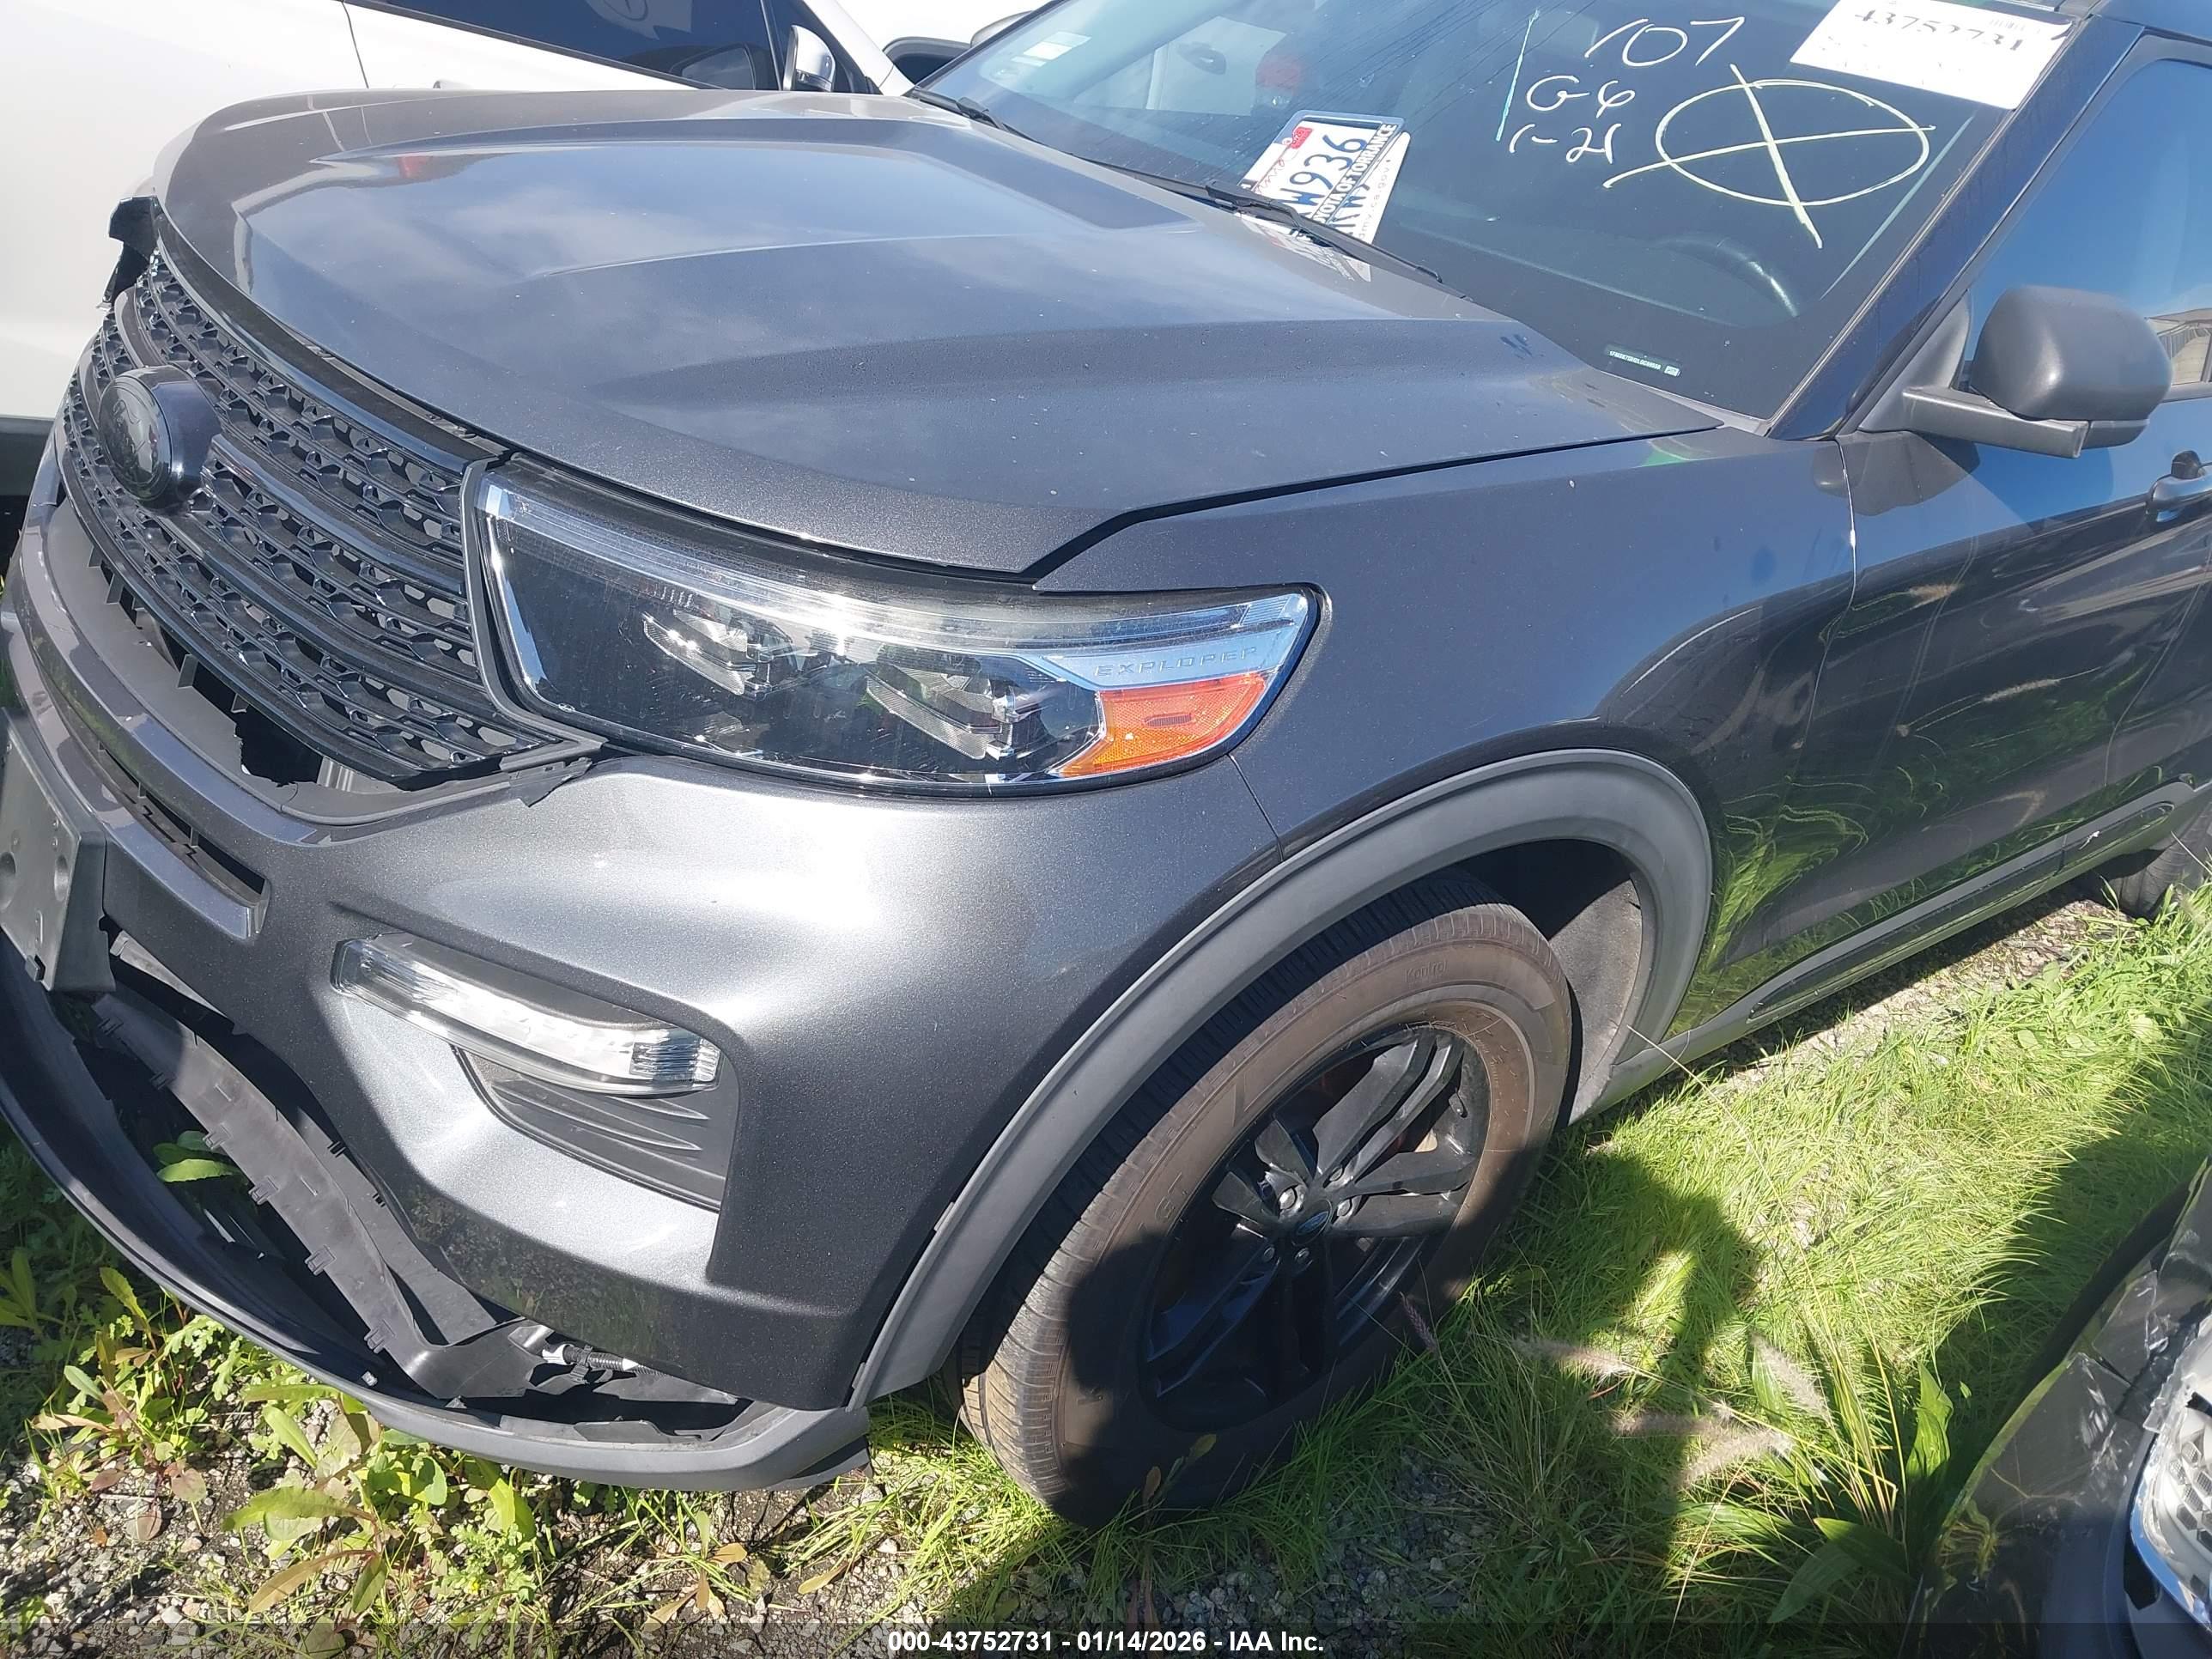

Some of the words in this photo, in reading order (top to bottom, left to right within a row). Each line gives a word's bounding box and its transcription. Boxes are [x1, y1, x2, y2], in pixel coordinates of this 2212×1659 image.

[1584, 17, 1745, 67] 107
[1335, 176, 1357, 192] OF
[1346, 125, 1398, 177] TORRANCE
[1094, 646, 1257, 677] EXPLORER
